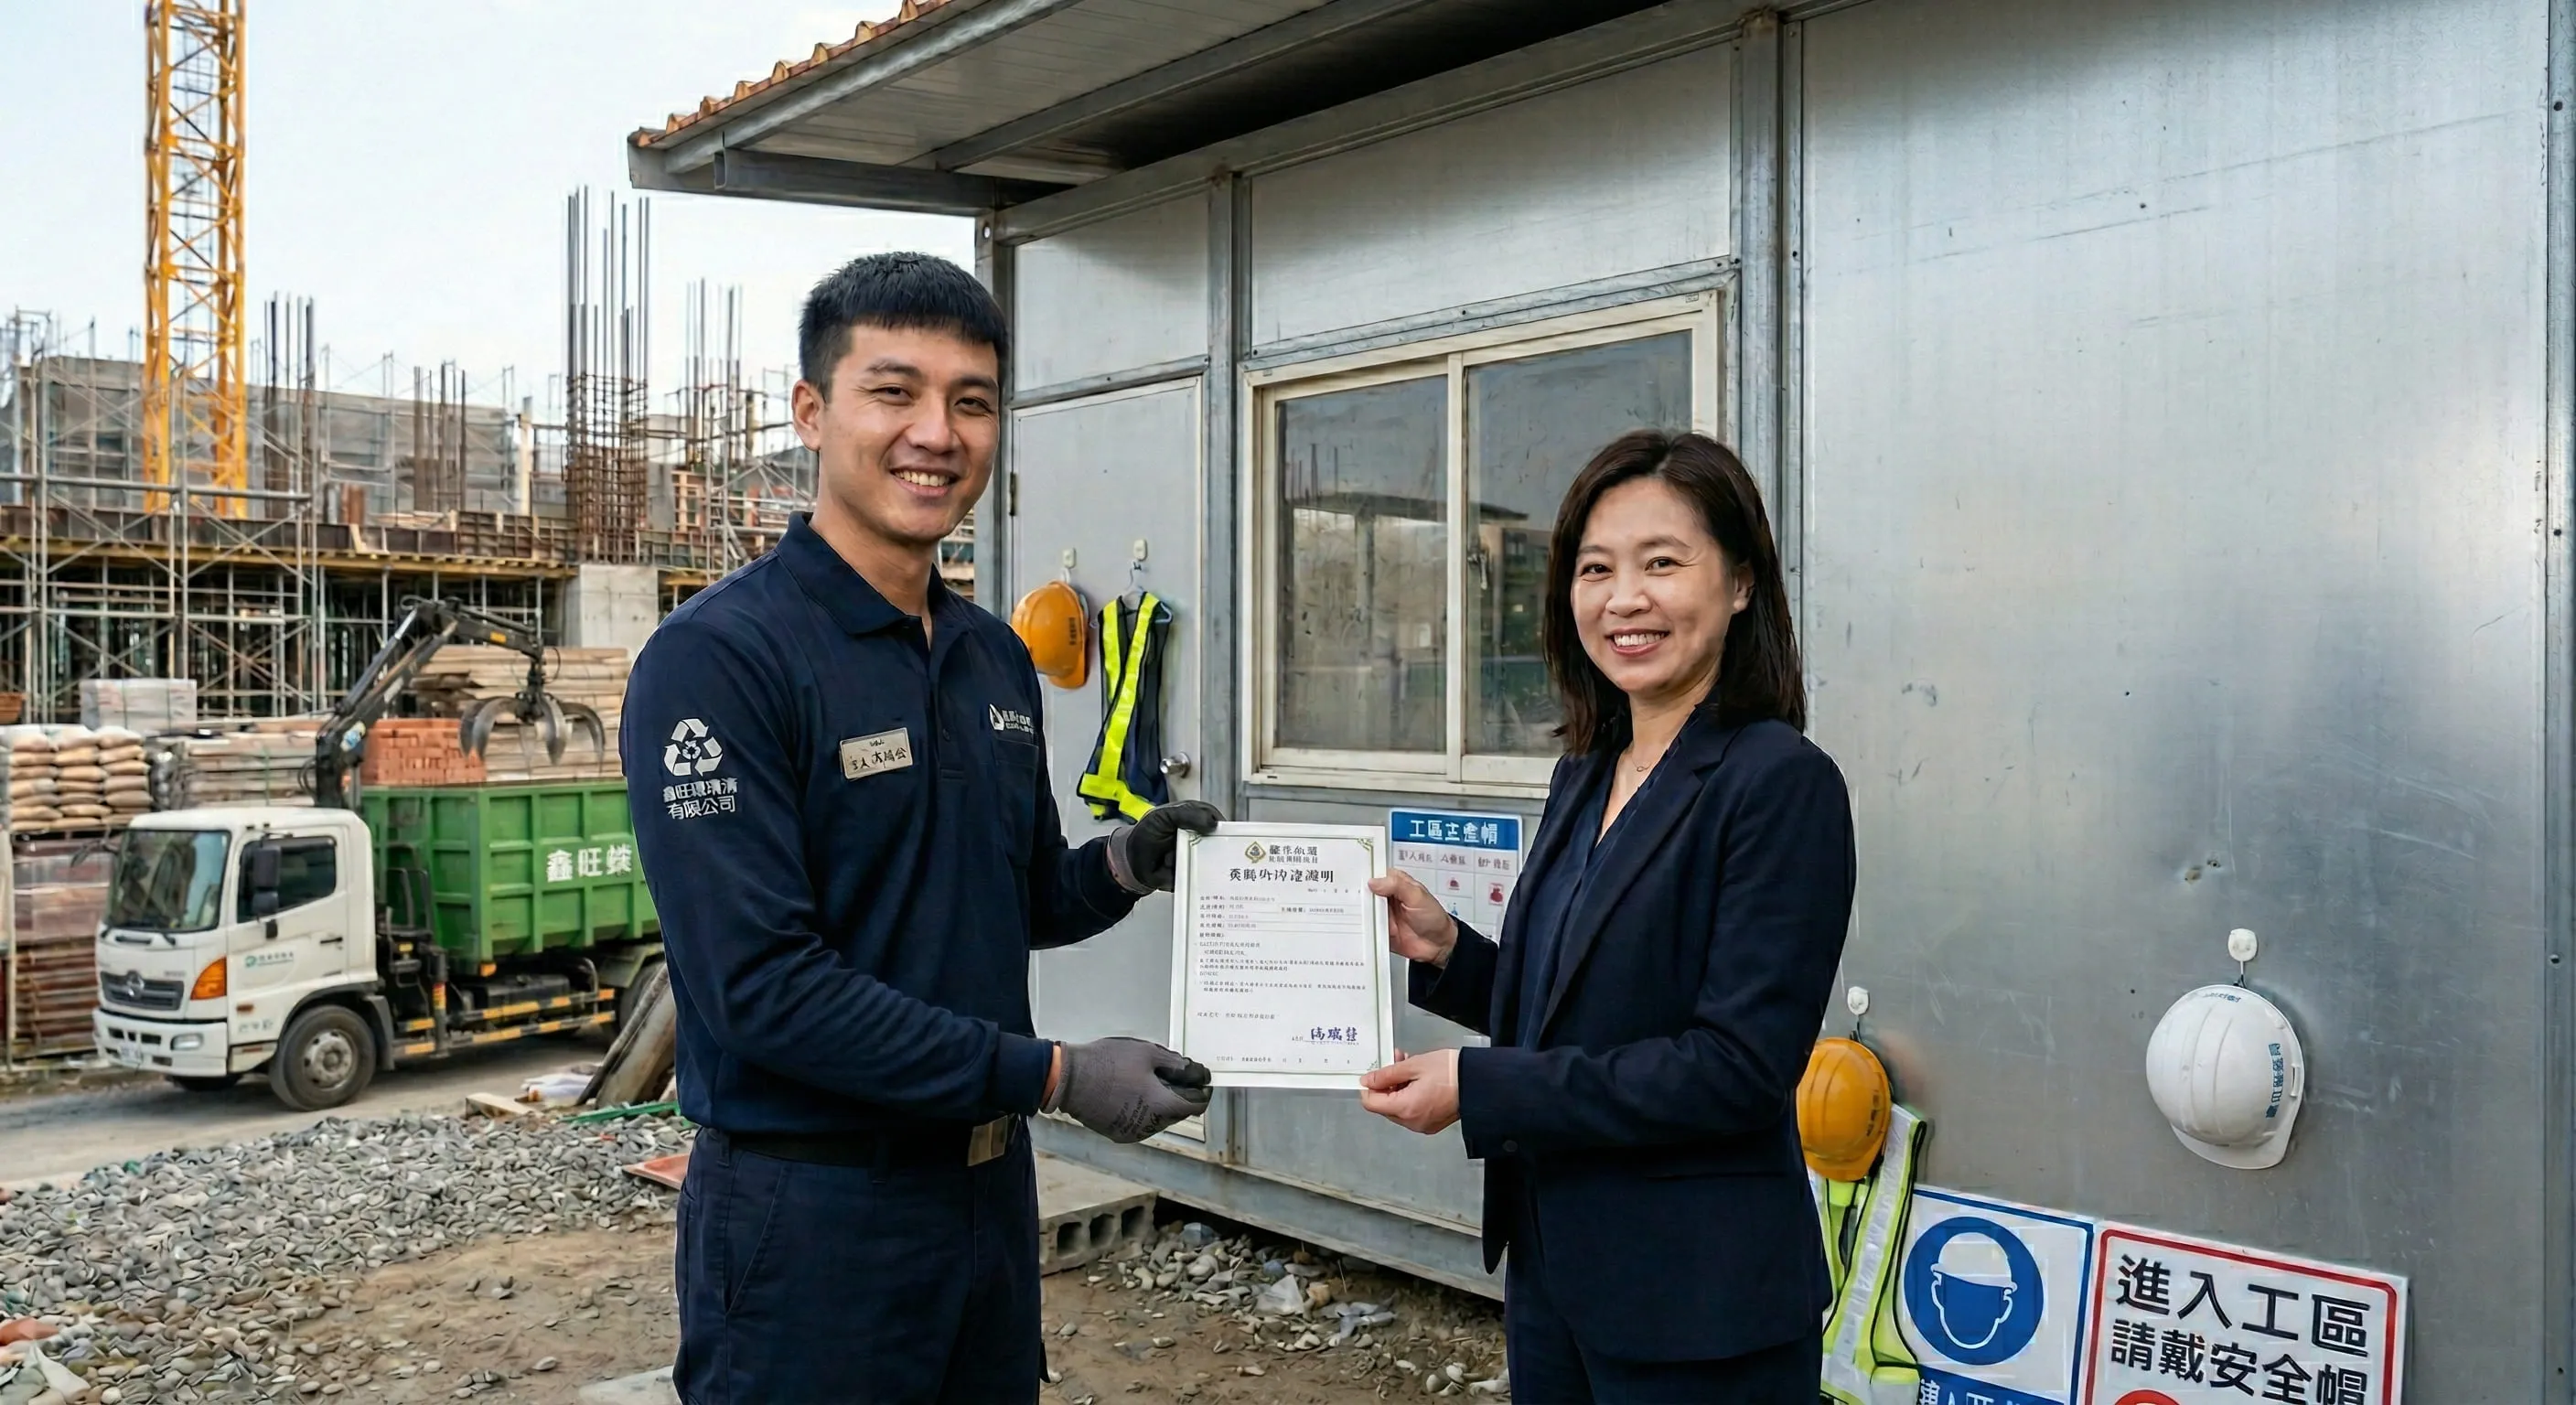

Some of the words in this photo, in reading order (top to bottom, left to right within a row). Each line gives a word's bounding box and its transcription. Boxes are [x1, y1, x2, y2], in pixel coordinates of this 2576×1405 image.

[666, 795, 735, 820] 有限公司
[2116, 1254, 2370, 1357] 進入工區
[2110, 1318, 2367, 1405] 請戴安全帽
